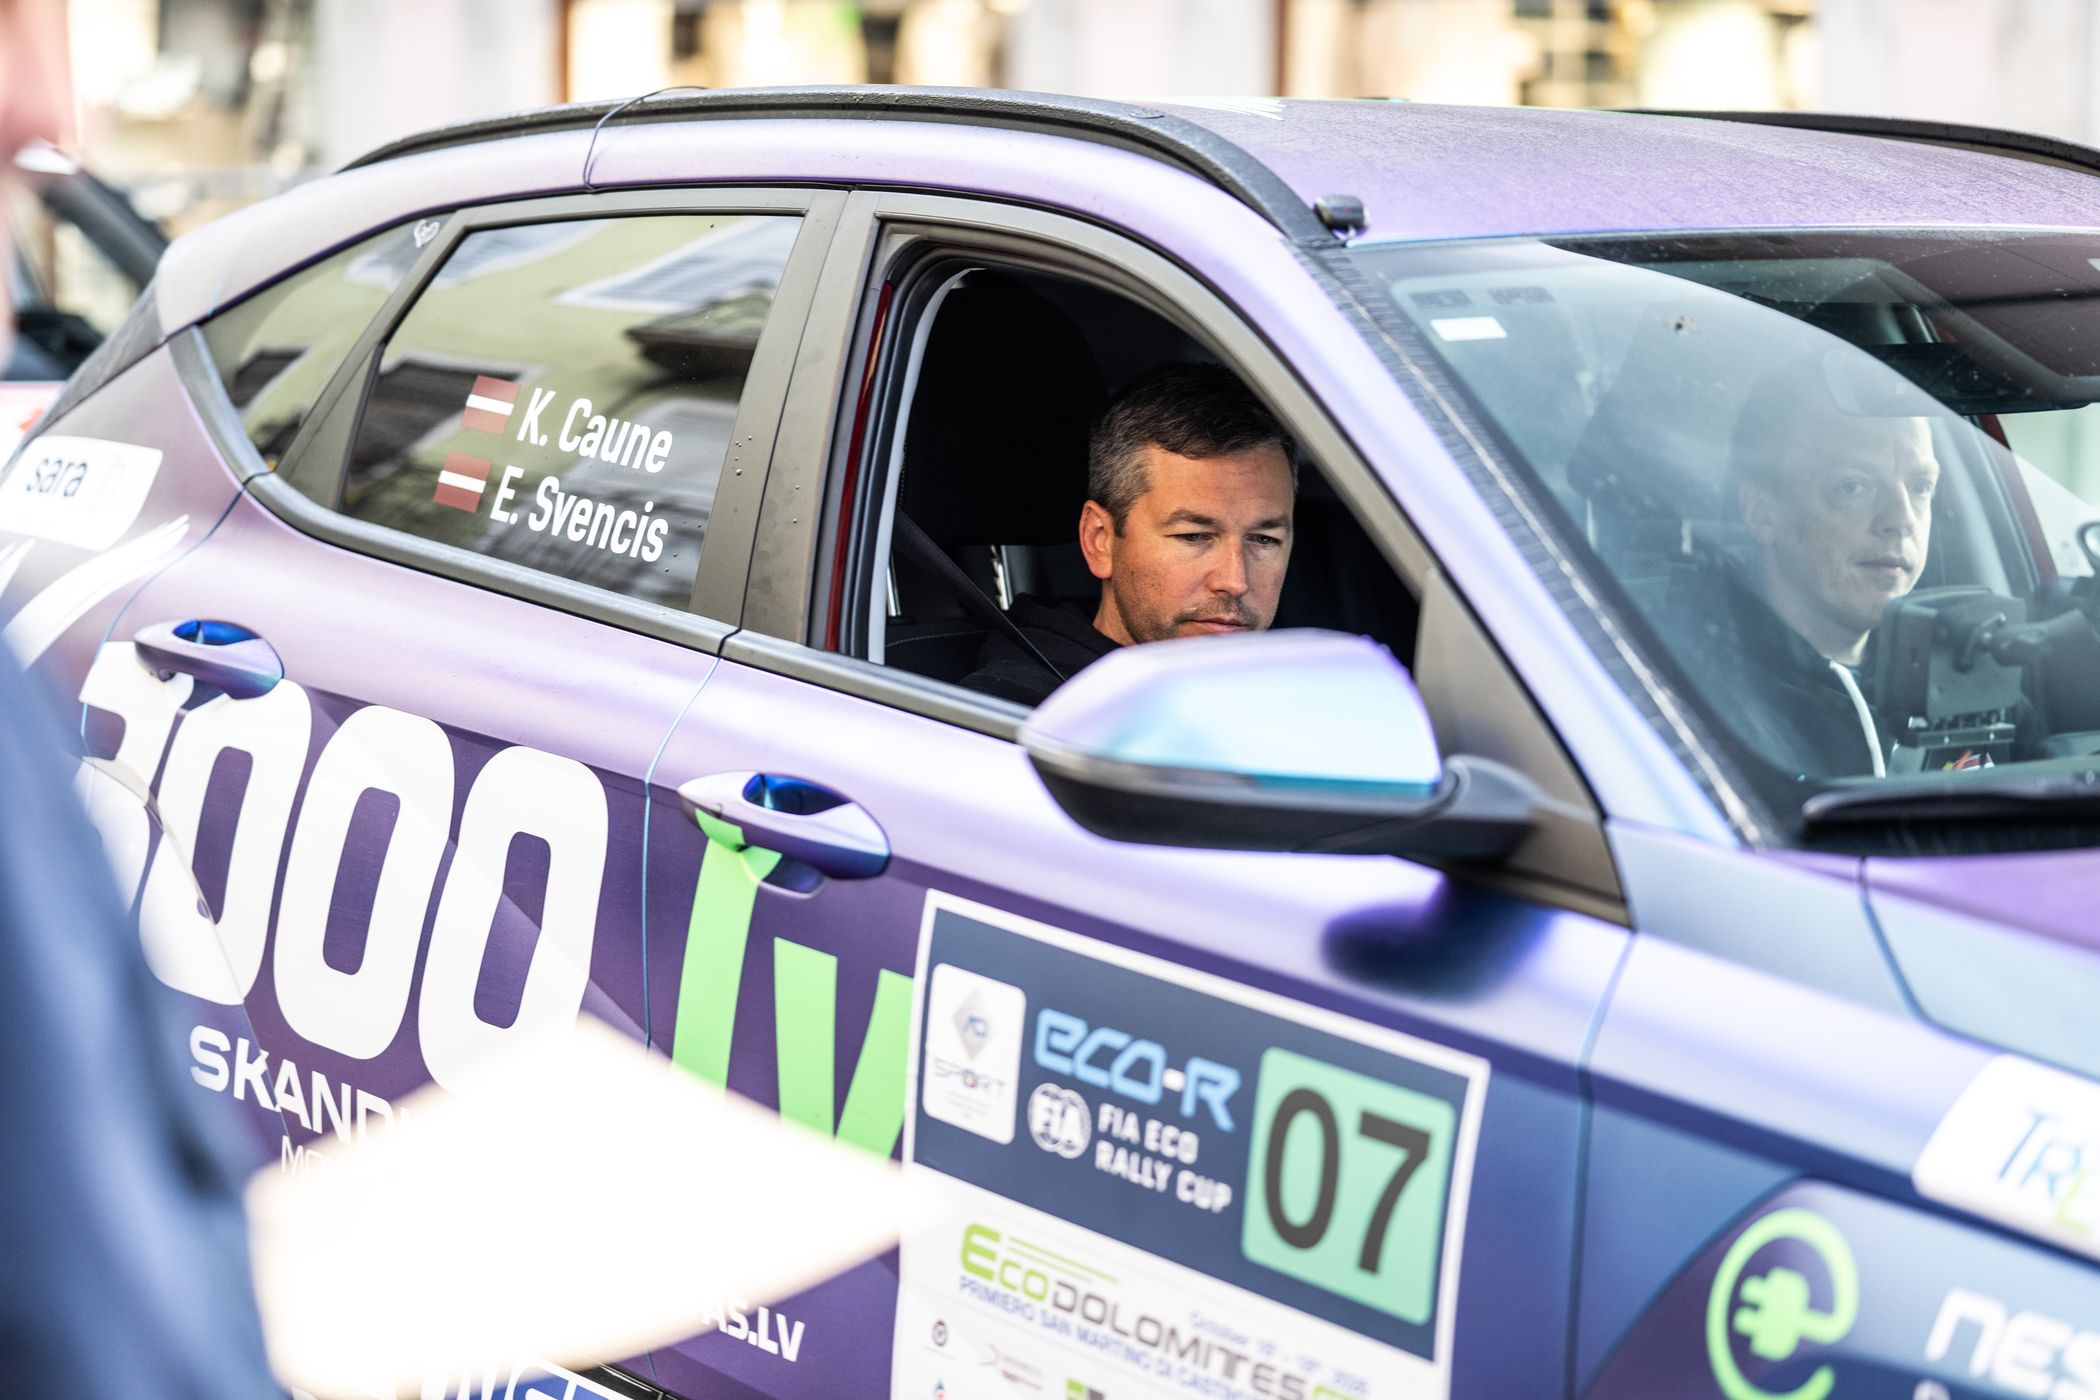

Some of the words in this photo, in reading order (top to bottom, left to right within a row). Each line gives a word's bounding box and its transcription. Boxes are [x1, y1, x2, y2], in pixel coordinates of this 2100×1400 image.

[516, 387, 556, 447] K.
[558, 398, 673, 473] Caune
[26, 458, 88, 497] sara
[490, 465, 525, 525] E.
[528, 476, 668, 562] Svencis
[1098, 1102, 1140, 1145] FIA
[1144, 1118, 1199, 1164] ECO
[1095, 1139, 1173, 1193] RALLY
[1176, 1169, 1232, 1213] CUP
[1265, 1087, 1431, 1274] 07
